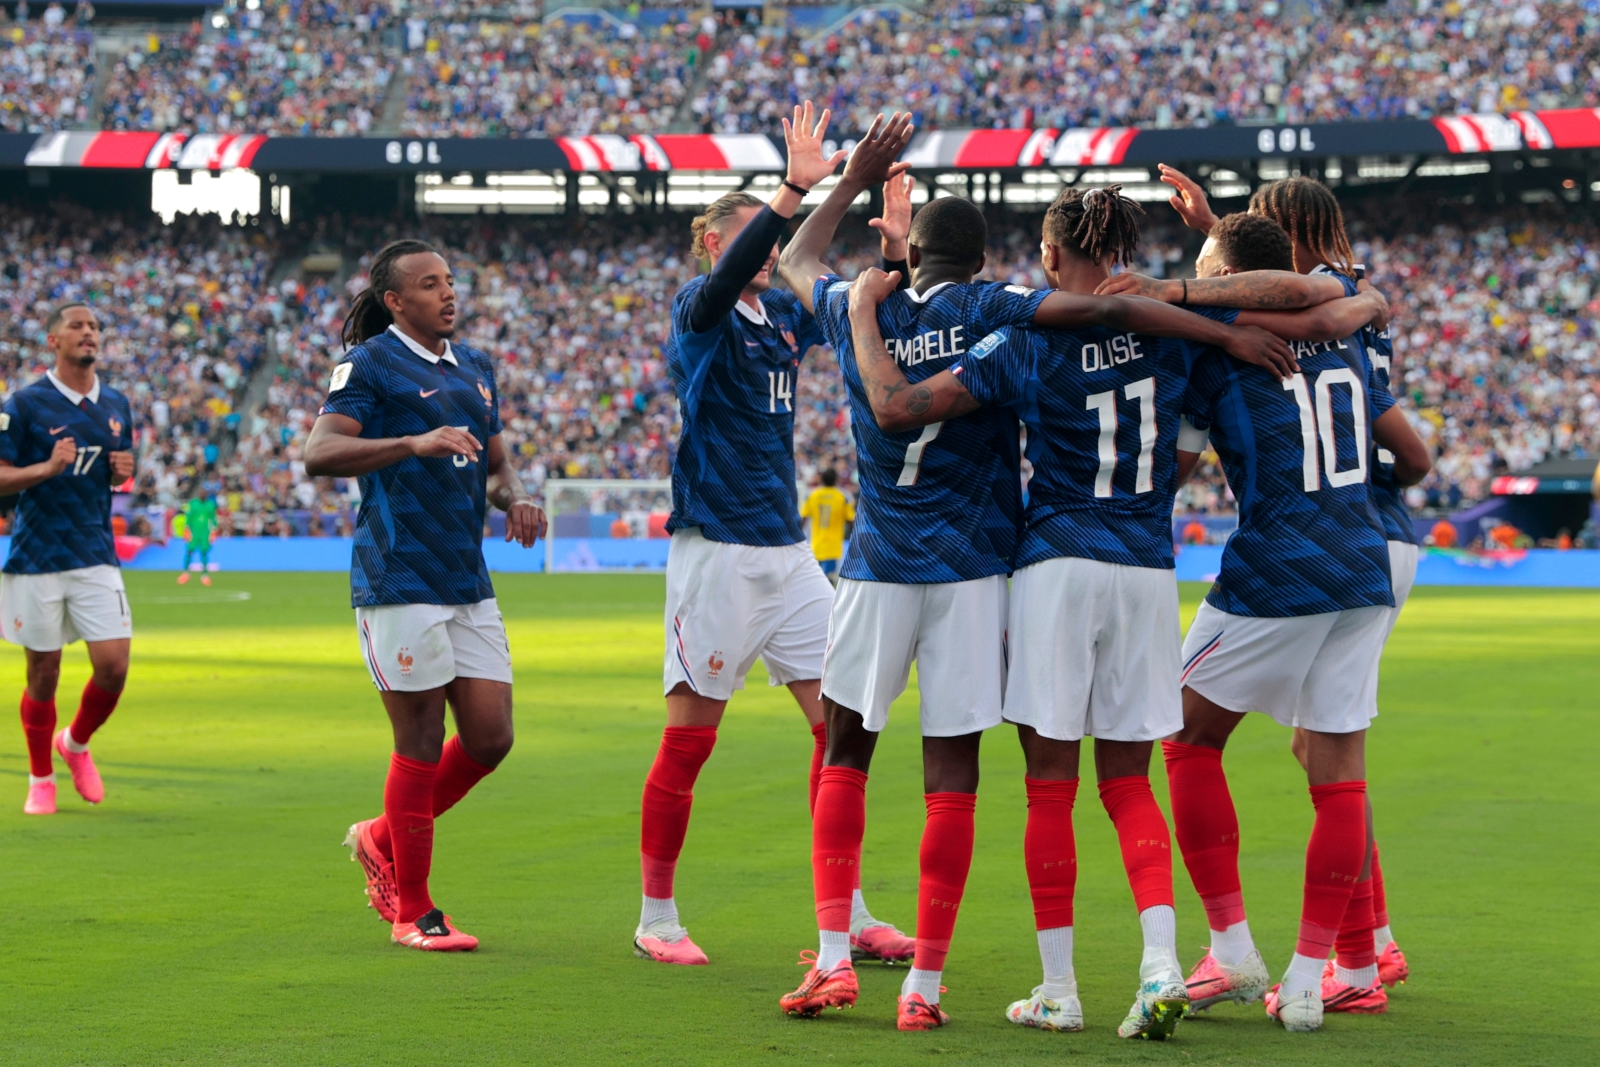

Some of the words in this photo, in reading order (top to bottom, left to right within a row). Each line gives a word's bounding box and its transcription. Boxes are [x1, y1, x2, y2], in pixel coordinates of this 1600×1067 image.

[385, 140, 442, 164] GOL
[1257, 127, 1316, 153] GOL
[1081, 332, 1144, 373] OLISE
[768, 371, 792, 413] 14
[1085, 376, 1158, 498] 11
[1282, 367, 1367, 492] 10
[73, 445, 103, 476] 17
[826, 857, 855, 867] FFF
